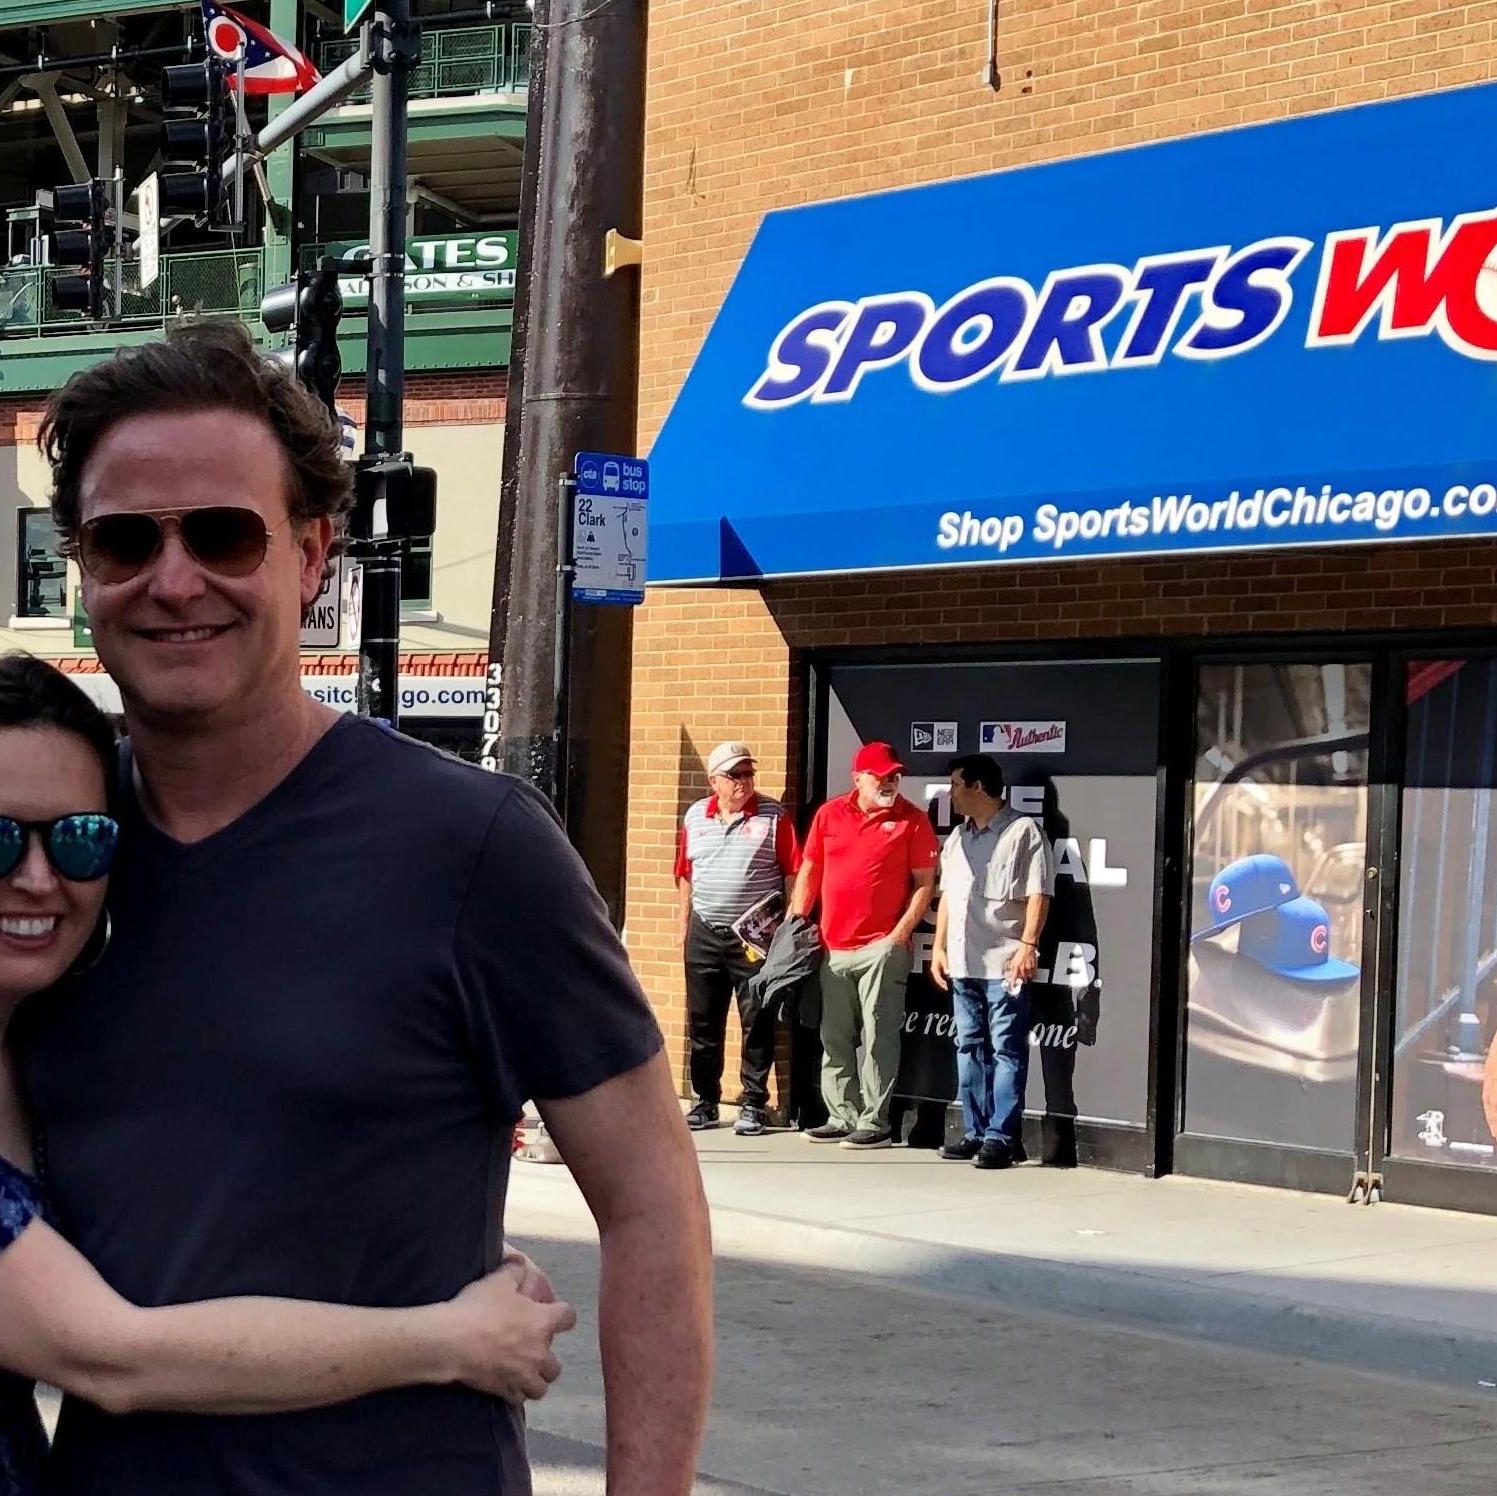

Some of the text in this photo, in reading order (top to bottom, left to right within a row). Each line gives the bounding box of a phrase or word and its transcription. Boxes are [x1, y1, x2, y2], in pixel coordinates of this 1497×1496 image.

[456, 274, 473, 288] &
[742, 237, 1314, 409] SPORTS
[623, 462, 643, 478] bus
[623, 478, 646, 495] stop
[578, 498, 593, 512] 22
[578, 512, 606, 527] Clark
[937, 483, 1497, 551] Shop SportsWorldChicago.co
[1007, 724, 1065, 750] Authentic
[926, 783, 1045, 828] TE
